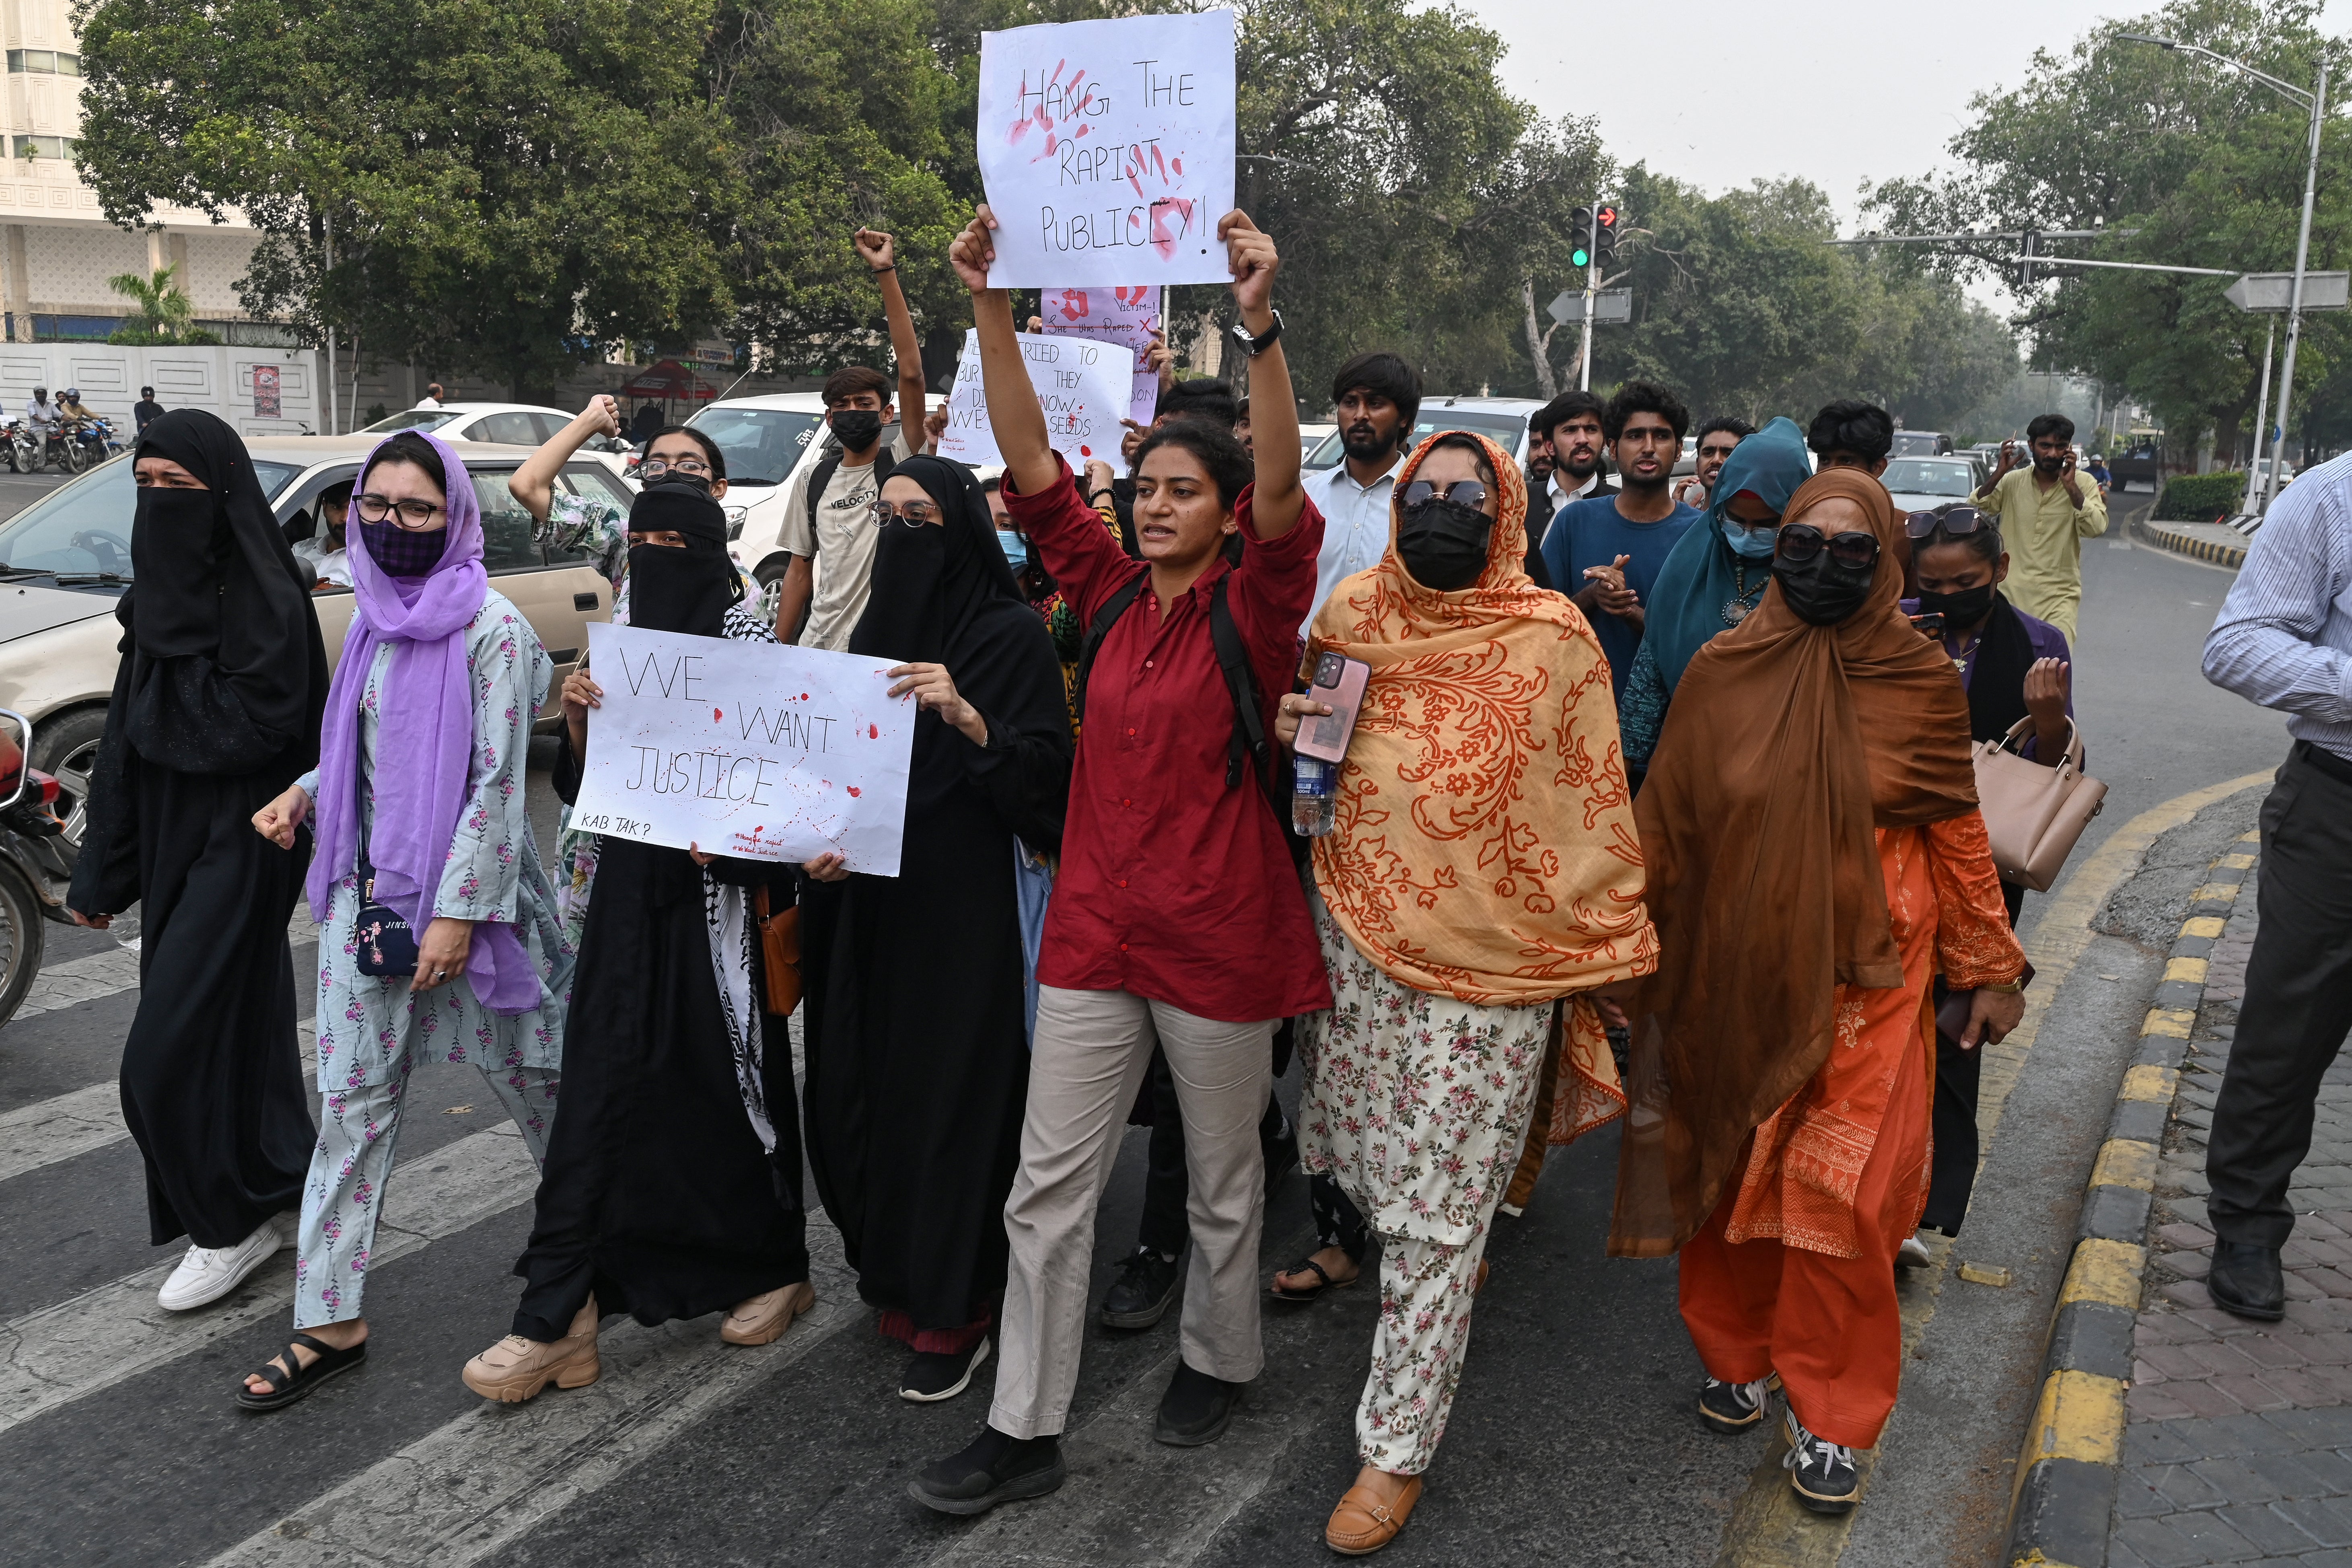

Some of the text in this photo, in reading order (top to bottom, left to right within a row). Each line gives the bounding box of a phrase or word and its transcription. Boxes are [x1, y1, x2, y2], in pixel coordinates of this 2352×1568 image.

[1021, 60, 1193, 122] HANG THE
[1052, 138, 1160, 186] RAPIST
[1042, 195, 1207, 254] PUBLICLY!
[1048, 315, 1133, 335] SHE WAS RAPED
[965, 338, 980, 355] THE
[1078, 346, 1098, 365] TO
[958, 362, 1082, 389] BUR THEY
[1037, 393, 1075, 412] NOW
[951, 406, 1091, 436] WE SEEDS
[797, 428, 814, 447] 5493
[831, 488, 875, 509] VELOCITY
[620, 647, 706, 701] WE
[737, 702, 837, 753] WANT
[626, 745, 779, 806] JUSTICE
[580, 813, 608, 829] KAB
[757, 847, 778, 856] Justice
